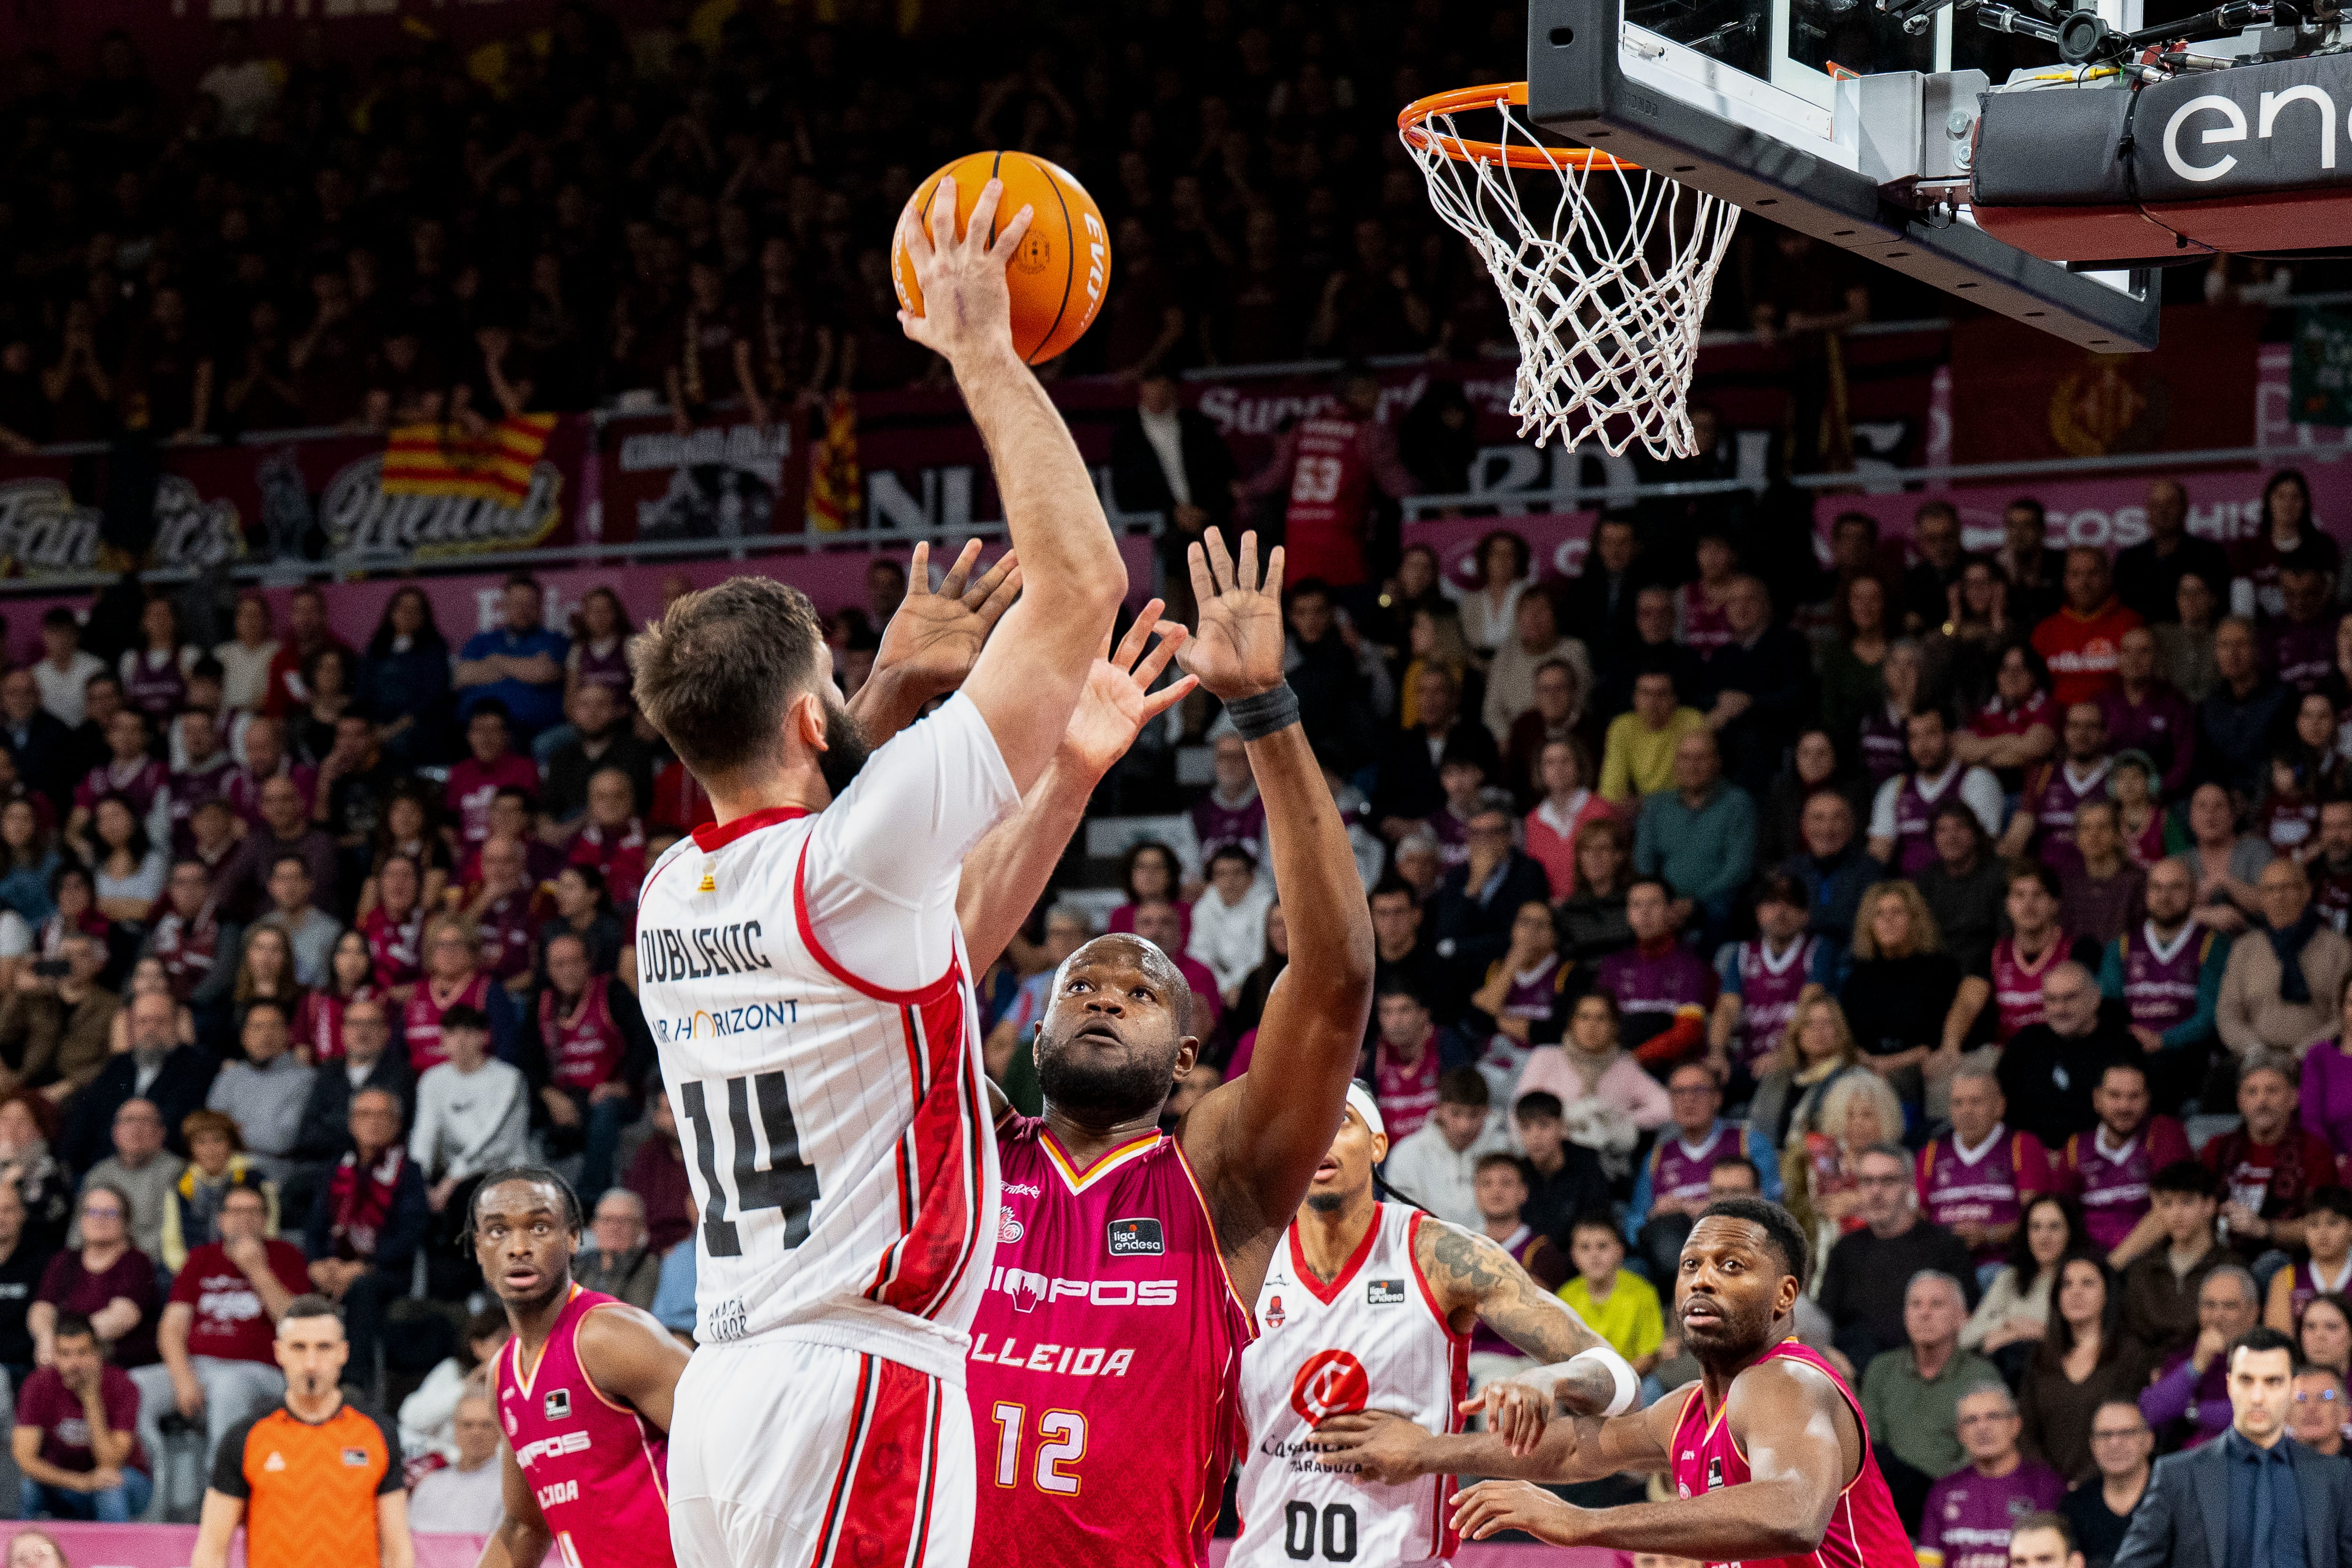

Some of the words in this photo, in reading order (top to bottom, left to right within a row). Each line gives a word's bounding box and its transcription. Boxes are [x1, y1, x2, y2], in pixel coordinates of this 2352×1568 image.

[2163, 85, 2352, 182] en
[1083, 213, 1104, 301] EVO
[681, 1070, 820, 1257] 14
[1114, 1231, 1136, 1242] liga
[1114, 1239, 1160, 1250] endesa
[1369, 1286, 1387, 1296] liga
[1369, 1293, 1404, 1303] endesa
[969, 1332, 1136, 1377] LLEIDA
[991, 1401, 1089, 1497] 12
[1285, 1500, 1357, 1562] 00
